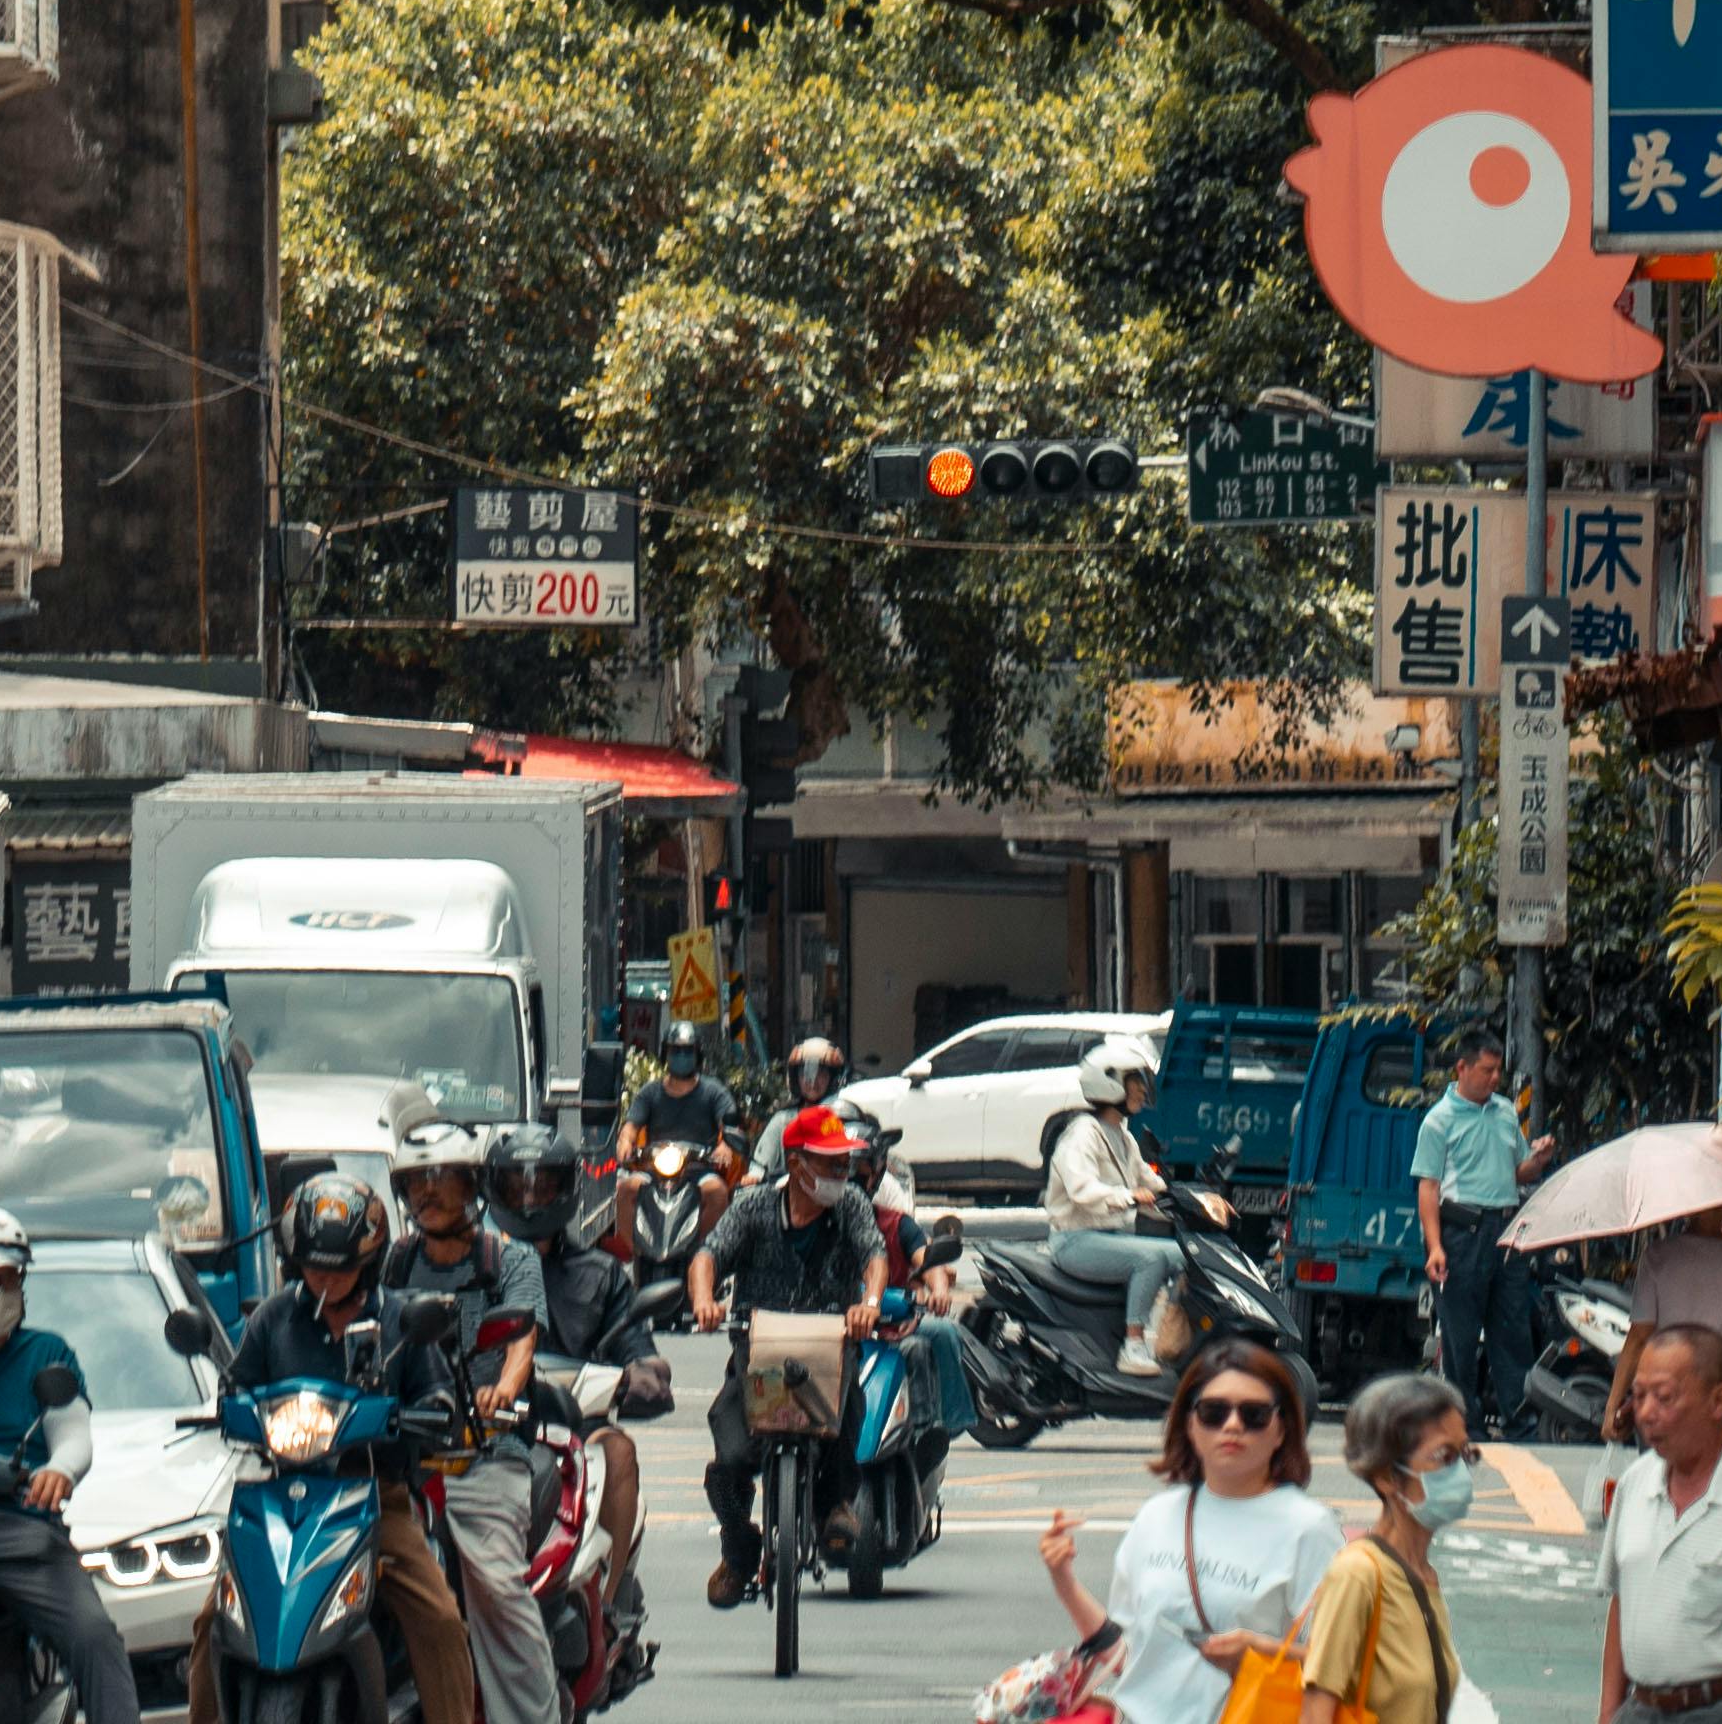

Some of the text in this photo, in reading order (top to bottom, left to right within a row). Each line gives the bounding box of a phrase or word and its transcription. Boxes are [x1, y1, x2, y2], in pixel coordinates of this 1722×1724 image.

[461, 570, 630, 617] 快剪200元
[1392, 501, 1467, 685] 批售
[1519, 755, 1548, 875] 玉成公園
[24, 881, 129, 963] 藝
